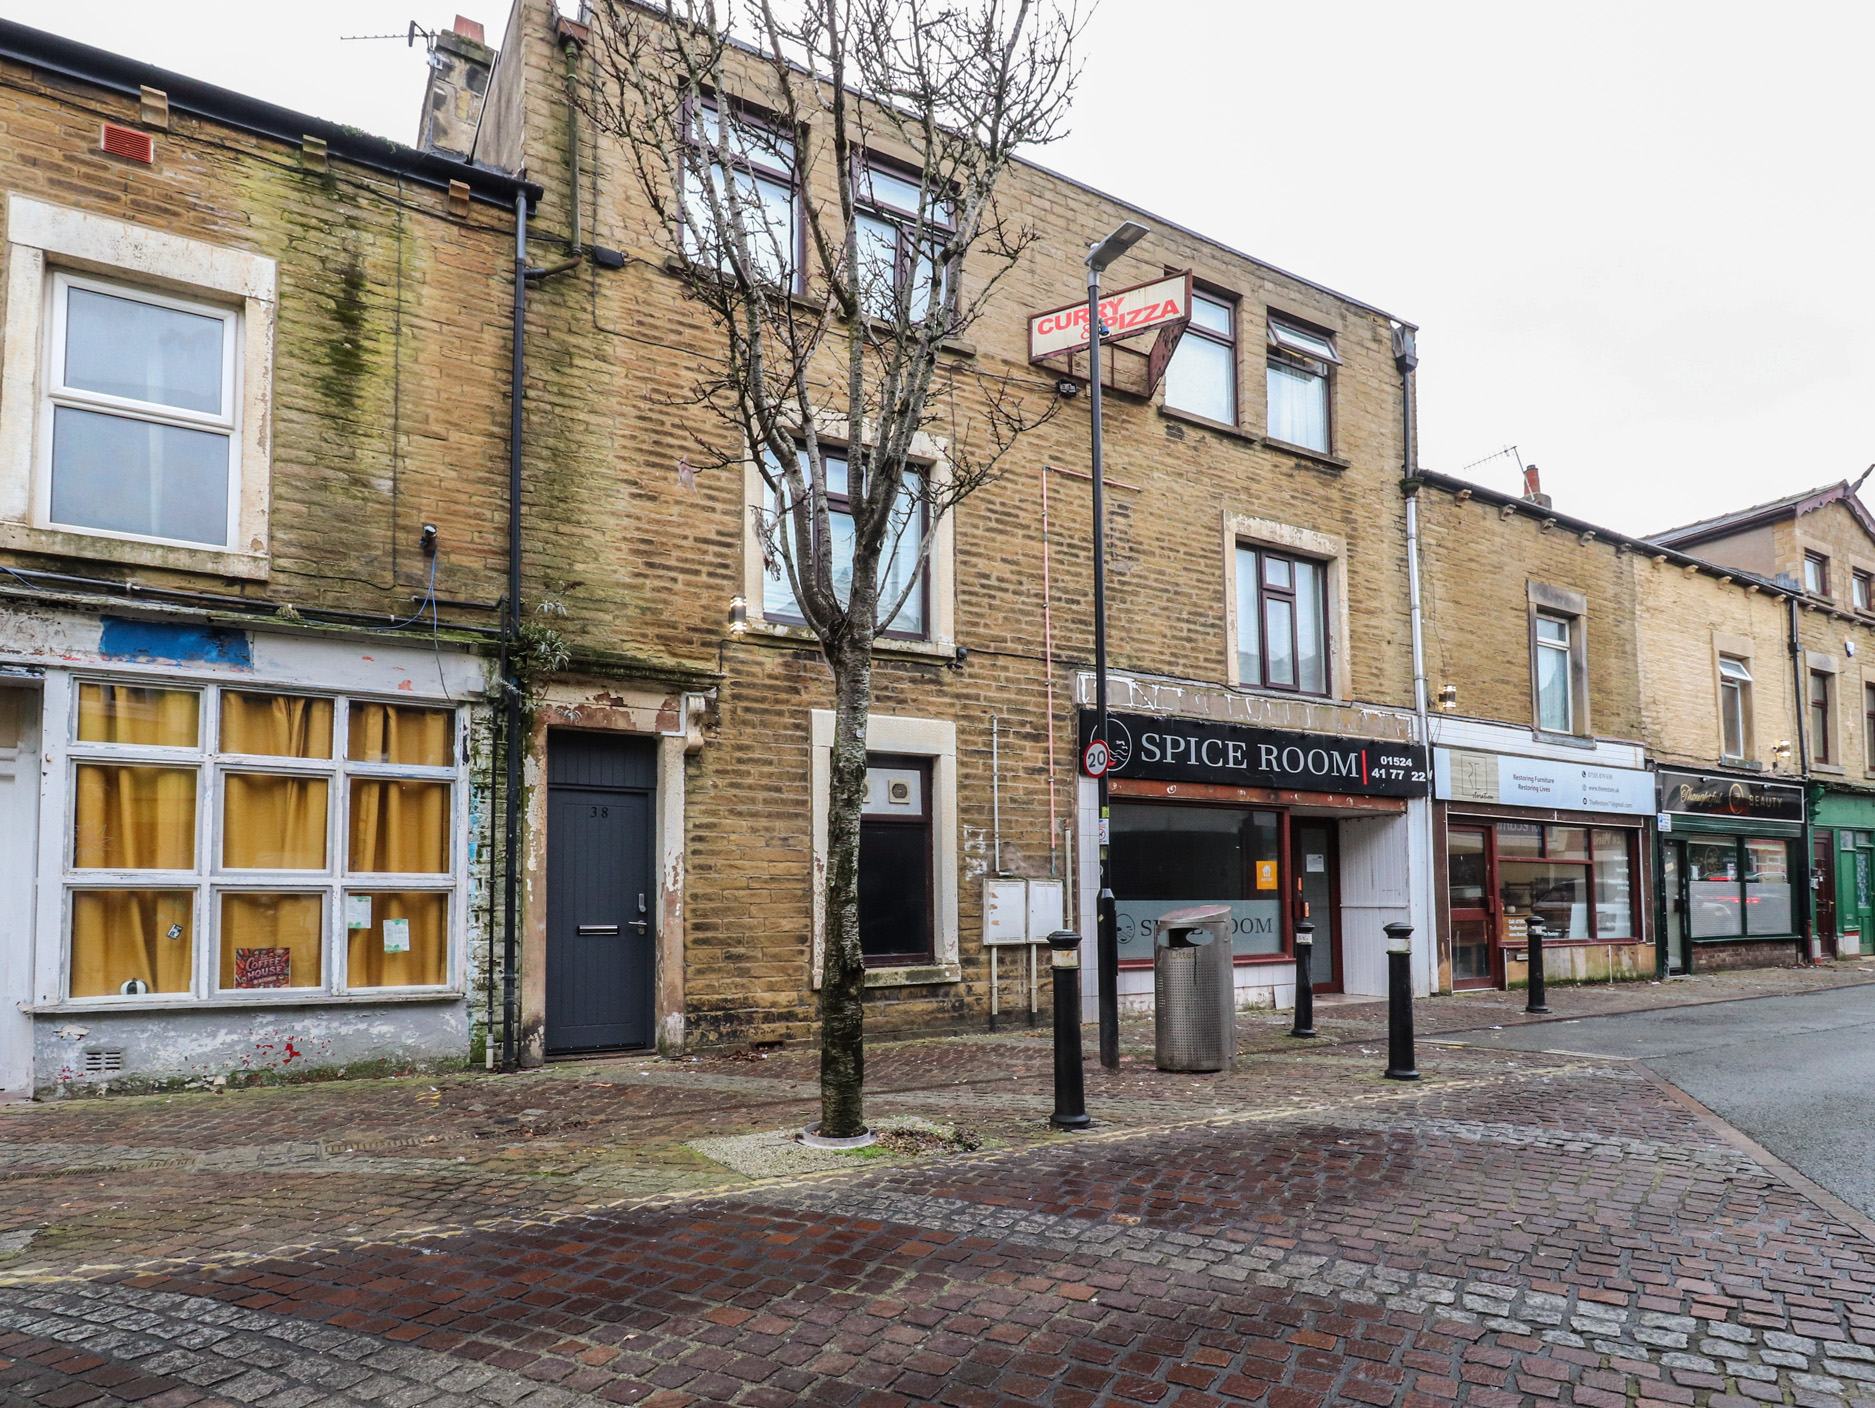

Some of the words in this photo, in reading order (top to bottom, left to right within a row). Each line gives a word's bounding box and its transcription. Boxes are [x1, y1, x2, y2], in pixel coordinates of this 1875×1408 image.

[1037, 296, 1126, 335] CURRY
[1105, 299, 1180, 330] PIZZA
[1087, 750, 1106, 768] 20
[1141, 732, 1248, 769] SPICE
[1257, 743, 1360, 778] ROOM
[1380, 755, 1413, 768] 01524
[1371, 767, 1386, 779] 41
[1389, 769, 1405, 780] 77
[1513, 773, 1534, 783] Restoring
[1534, 775, 1555, 784] Furniture
[1518, 783, 1539, 793] Restoring
[1540, 784, 1551, 793] Lives
[1680, 783, 1722, 808] Thoughtful
[1749, 794, 1783, 808] BEAUTY
[590, 806, 609, 819] 38
[1170, 951, 1195, 960] Litter
[245, 957, 282, 972] COFFEE
[247, 965, 283, 981] HOUSE
